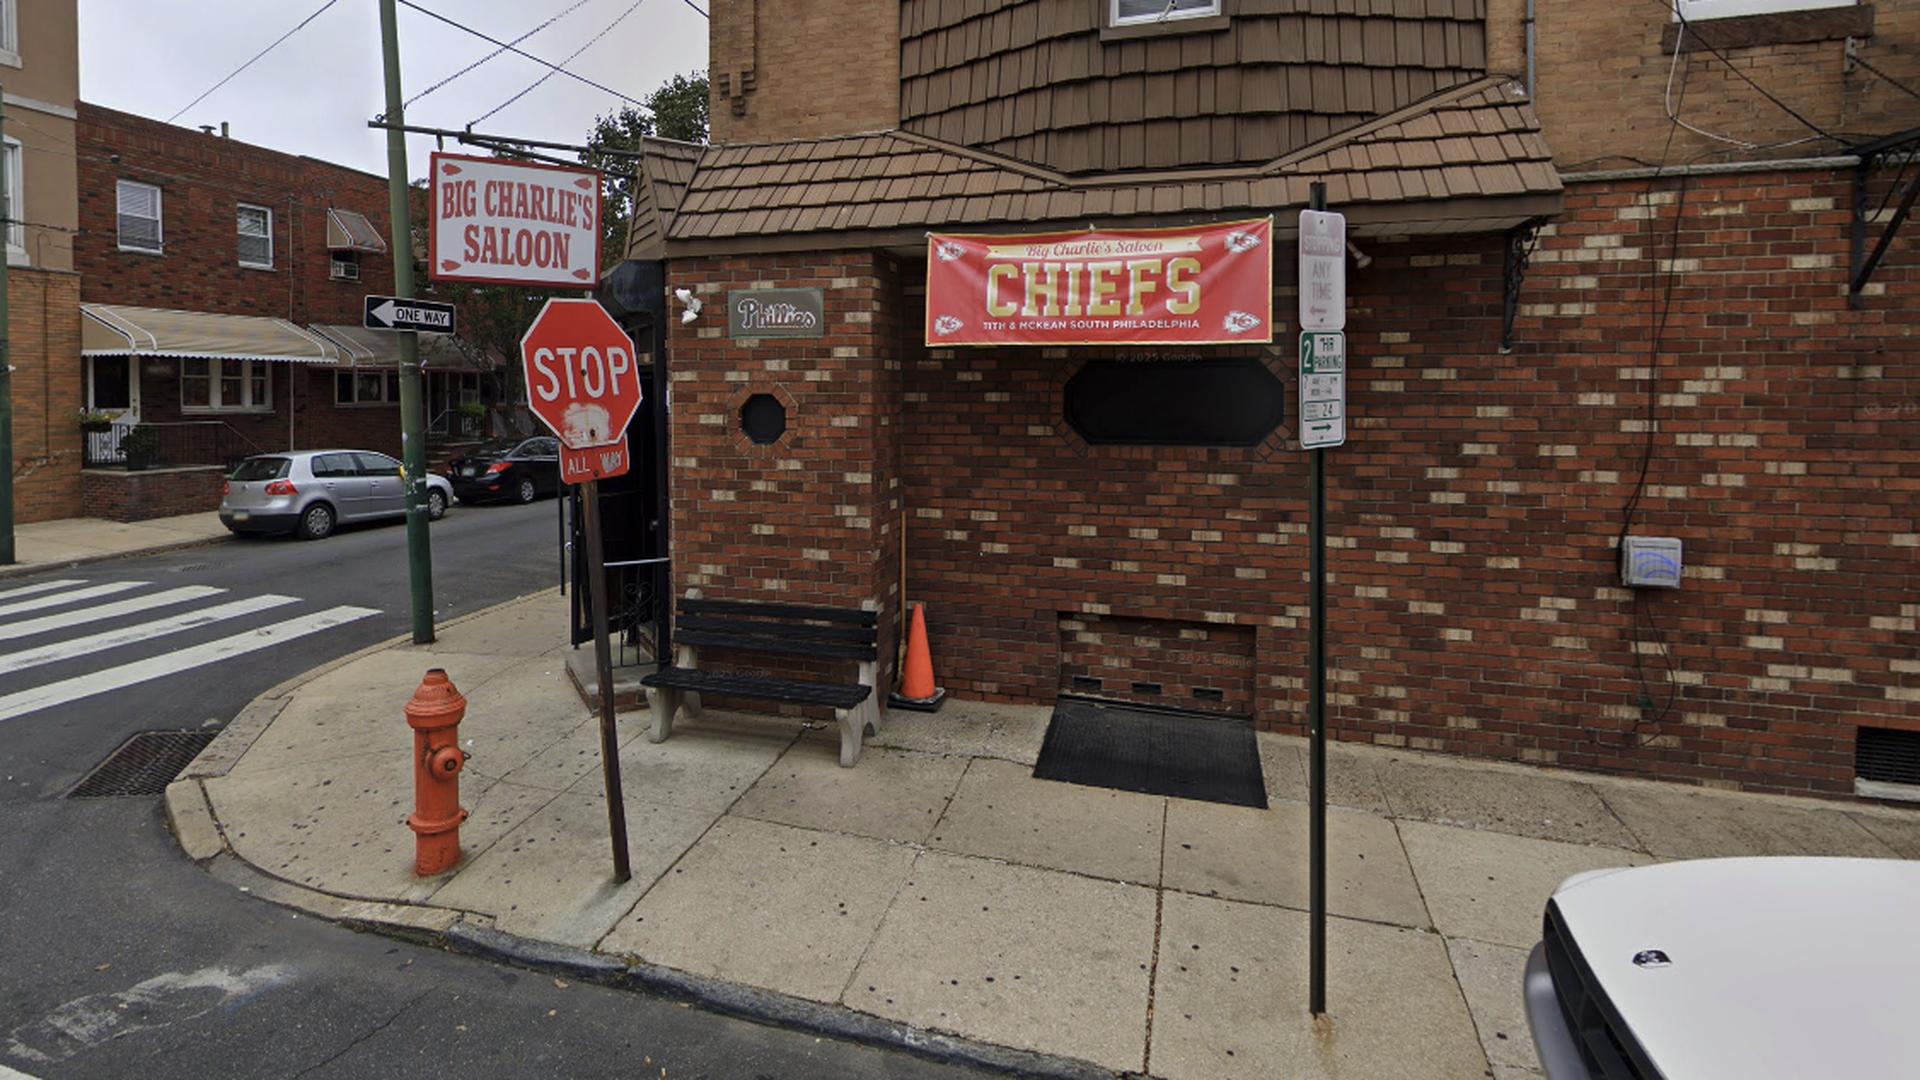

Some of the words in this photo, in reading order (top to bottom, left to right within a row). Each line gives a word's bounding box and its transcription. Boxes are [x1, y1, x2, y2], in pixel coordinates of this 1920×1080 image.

[441, 180, 476, 219] BIG
[484, 180, 593, 231] CHARLIE'S
[463, 224, 571, 270] SALOON
[1025, 245, 1049, 258] Big
[1053, 240, 1111, 257] Charlie's
[1115, 240, 1163, 254] Saloon
[1303, 235, 1341, 253] STOPPING
[1311, 260, 1333, 279] ANY
[986, 257, 1201, 318] CHIEFS
[1311, 281, 1333, 301] TIME
[396, 308, 420, 321] ONE
[424, 311, 447, 324] WAY
[737, 298, 816, 329] Phillies
[983, 321, 1006, 330] 11TH
[1009, 322, 1016, 330] &
[1019, 321, 1067, 330] MCKEAN
[1070, 320, 1110, 329] SOUTH
[1113, 320, 1200, 329] PHILADELPHIA
[1303, 339, 1312, 368] 2
[534, 346, 629, 402] STOP
[567, 457, 591, 476] ALL
[600, 450, 623, 474] WAY
